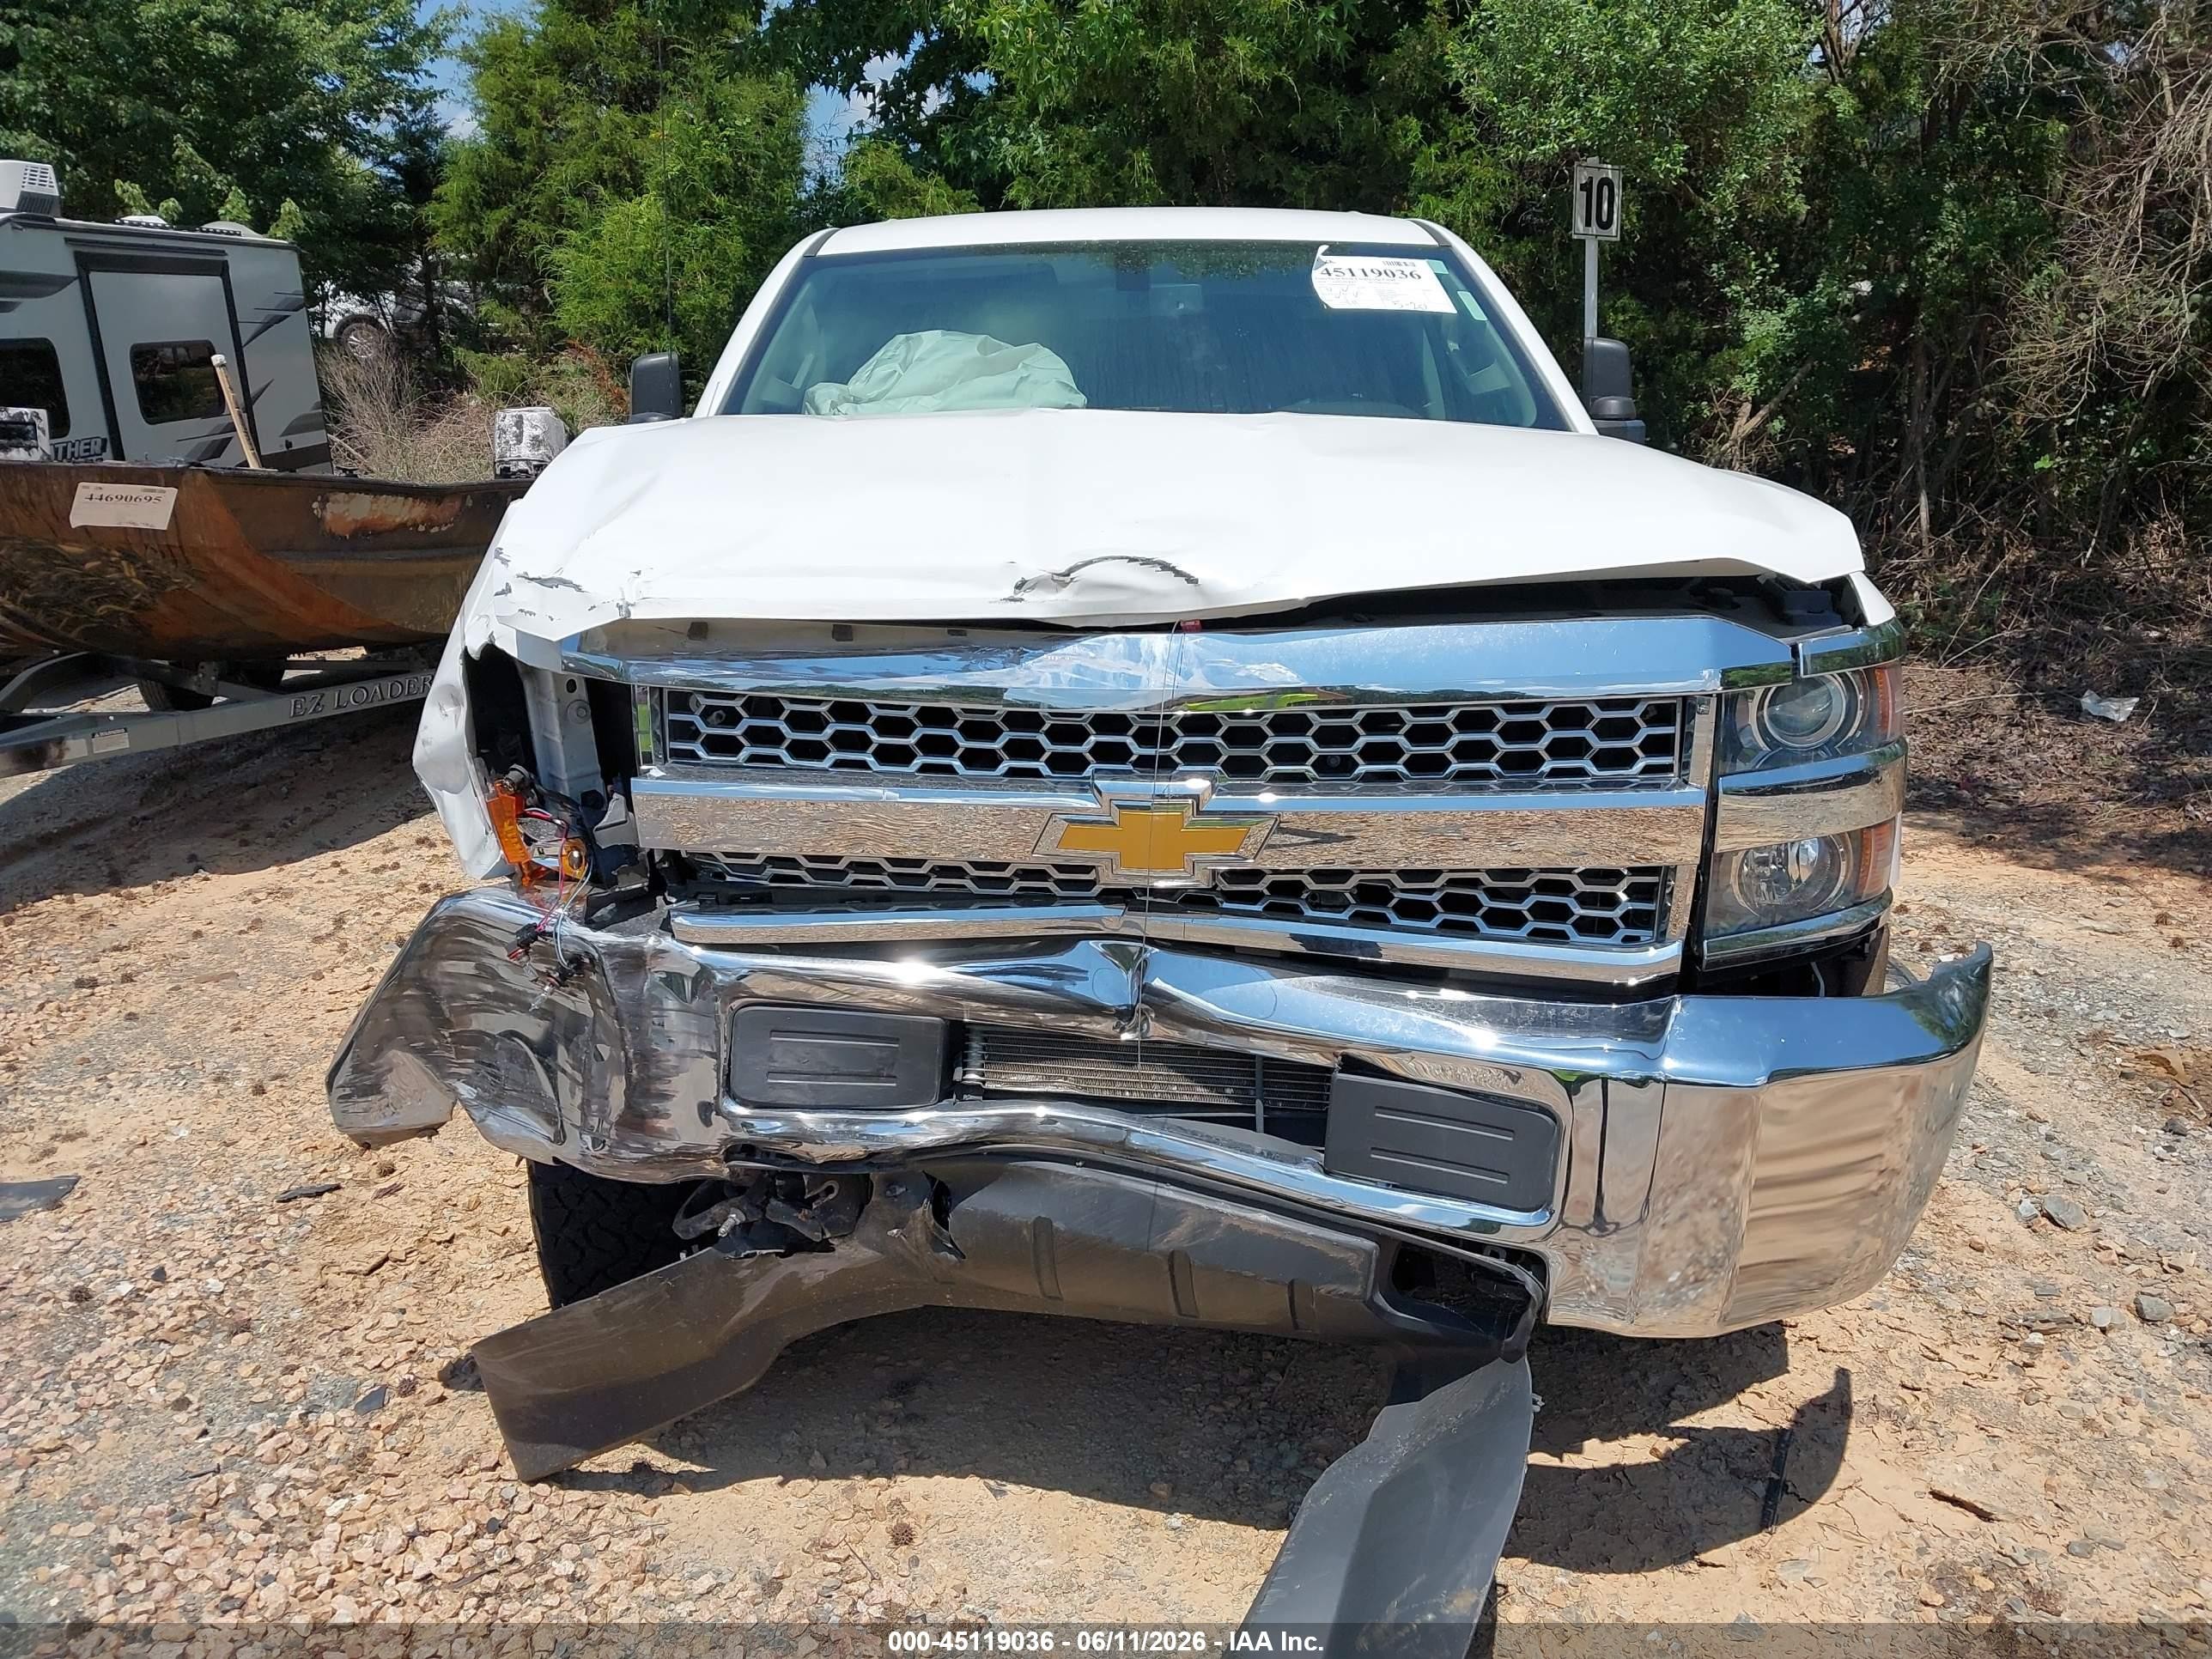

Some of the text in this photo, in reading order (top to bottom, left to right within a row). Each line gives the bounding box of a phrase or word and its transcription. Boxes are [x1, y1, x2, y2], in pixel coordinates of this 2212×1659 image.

[1579, 176, 1615, 230] 10
[1319, 266, 1422, 281] 45119036
[84, 493, 163, 504] 44690695
[289, 674, 432, 718] EZ LOADER
